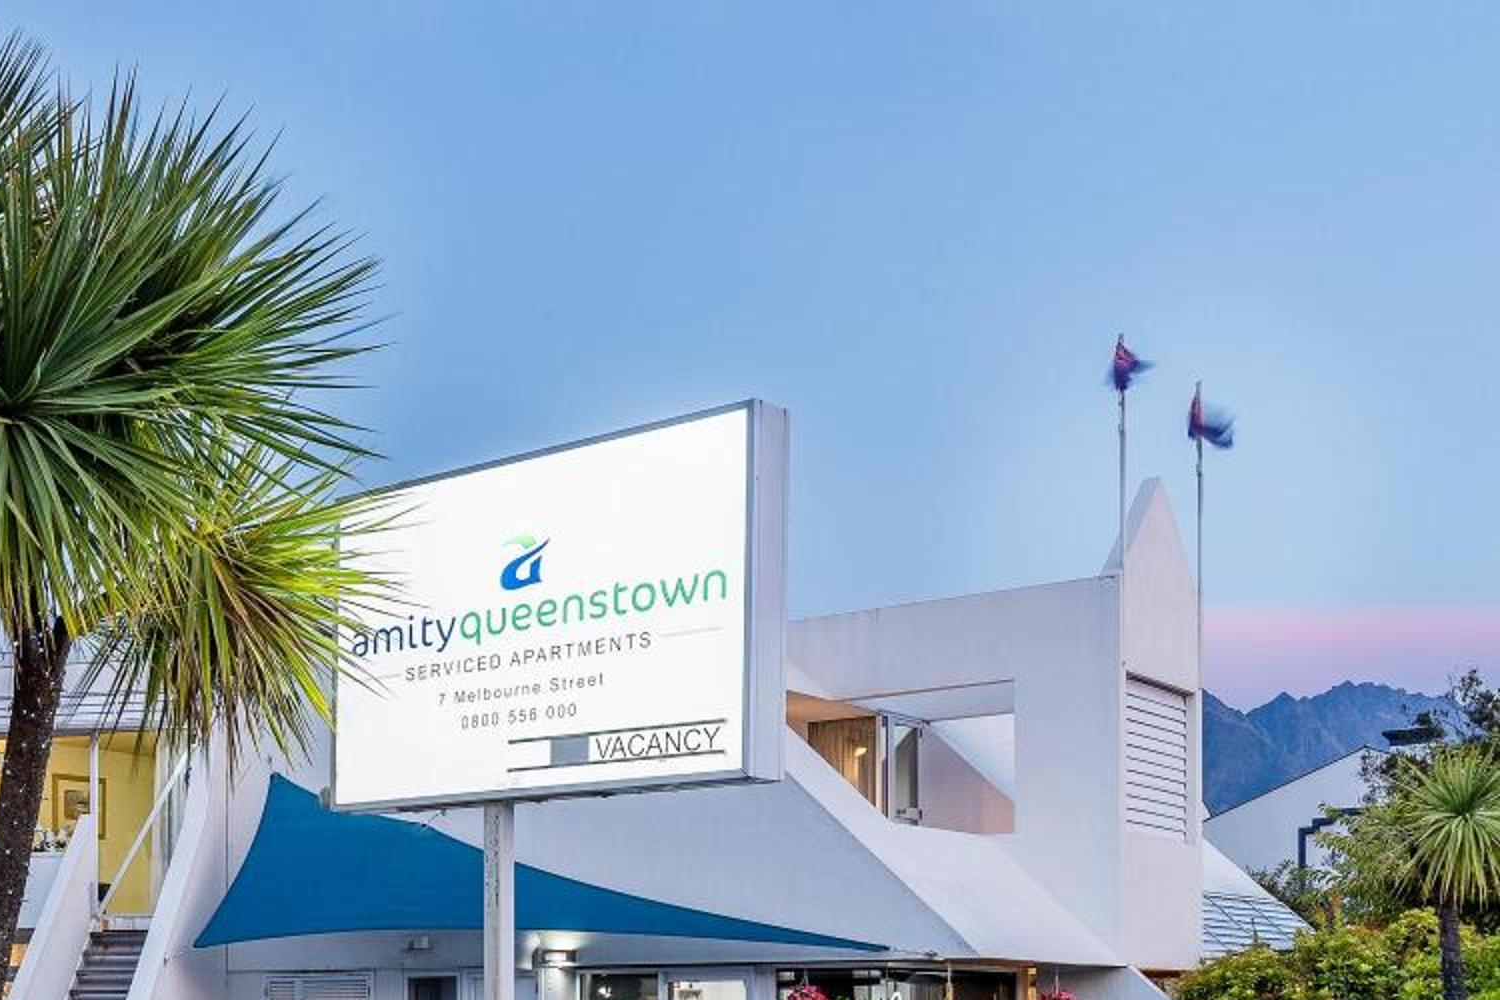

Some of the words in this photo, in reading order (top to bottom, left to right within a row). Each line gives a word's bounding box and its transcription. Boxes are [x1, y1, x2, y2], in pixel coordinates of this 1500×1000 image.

[404, 652, 502, 682] SERVICED
[509, 631, 652, 668] APARTMENTS
[454, 679, 541, 704] Melbourne
[549, 672, 604, 693] Street
[461, 711, 500, 731] 0800
[545, 702, 578, 719] 000
[595, 725, 721, 760] VACANCY
